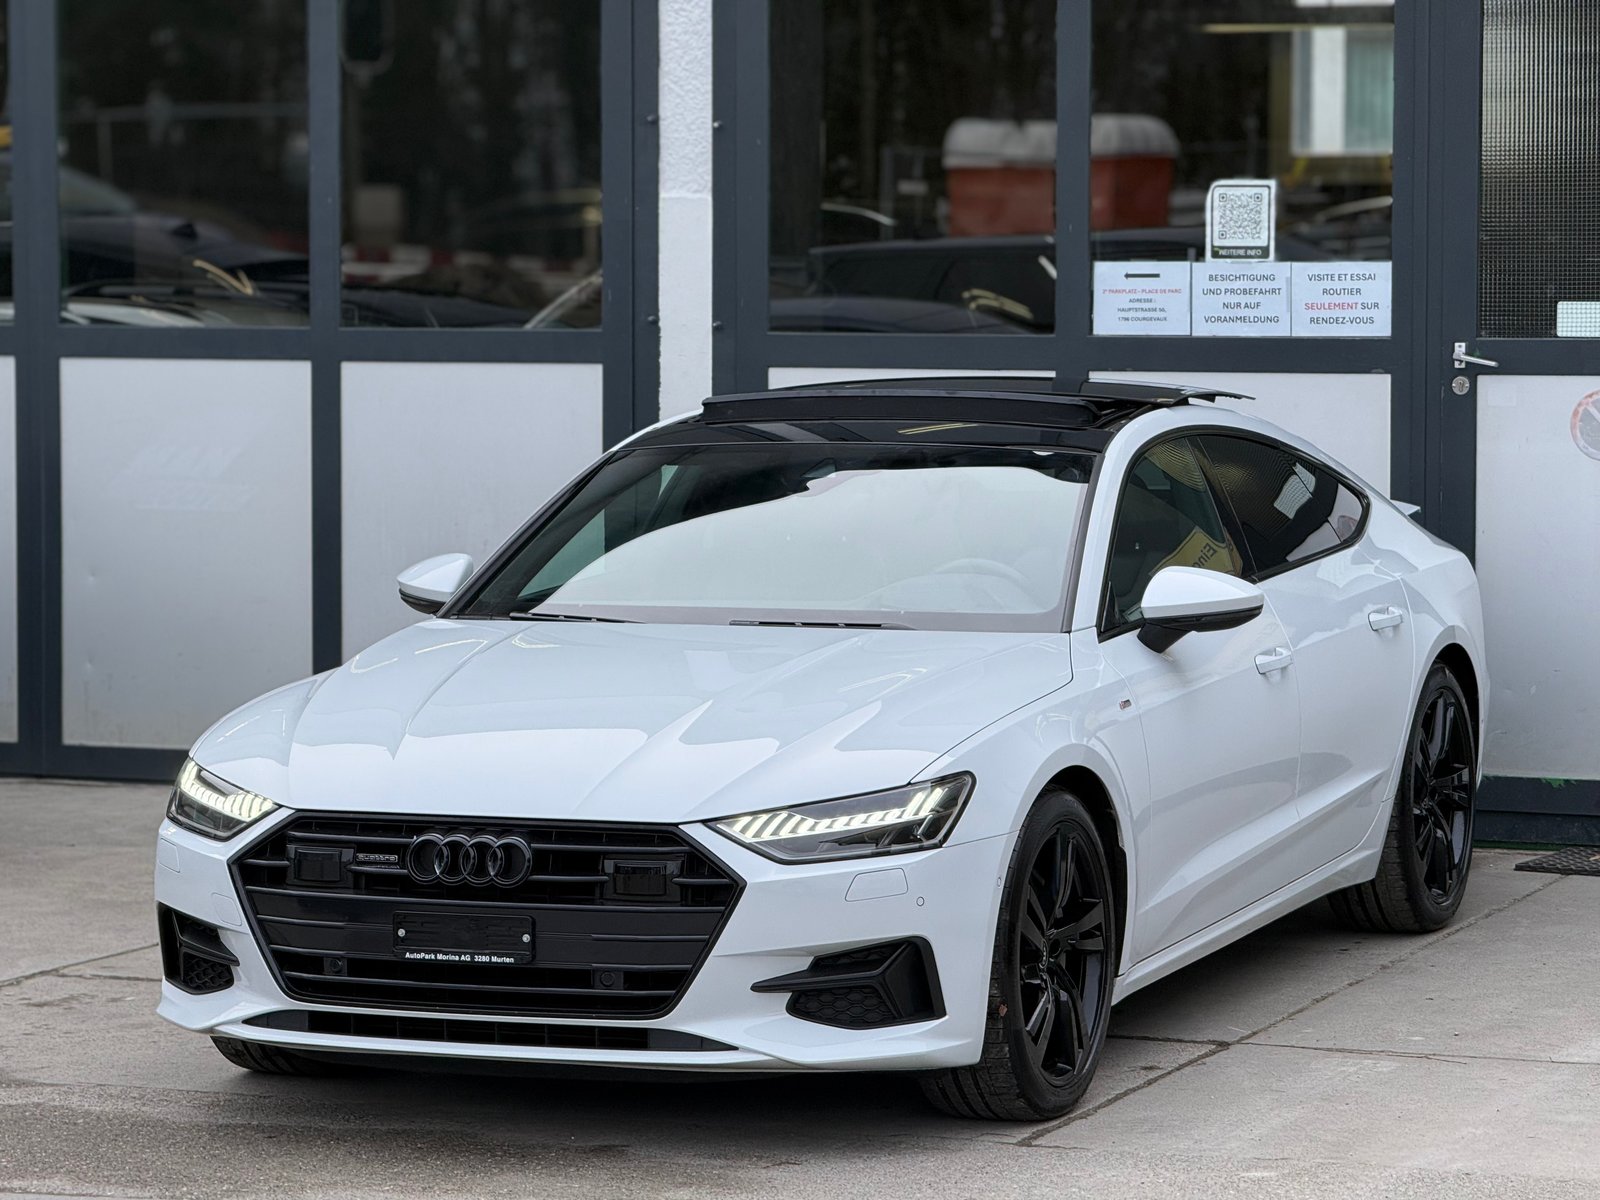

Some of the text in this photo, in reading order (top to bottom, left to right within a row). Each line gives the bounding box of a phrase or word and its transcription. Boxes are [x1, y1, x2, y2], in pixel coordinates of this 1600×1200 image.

[1208, 274, 1276, 282] BESICHTIGUNG
[1350, 273, 1376, 281] ESSAI
[1202, 288, 1282, 296] UND PROBEFAHRT
[1322, 288, 1361, 296] ROUTIER
[1222, 302, 1261, 310] NUR AUF
[1304, 302, 1380, 310] SEULEMENT SUR
[1204, 316, 1280, 324] VORANMELDUNG
[1309, 316, 1375, 324] RENDEZ-VOUS
[405, 952, 435, 960] AutoPark
[436, 953, 459, 961] Morina
